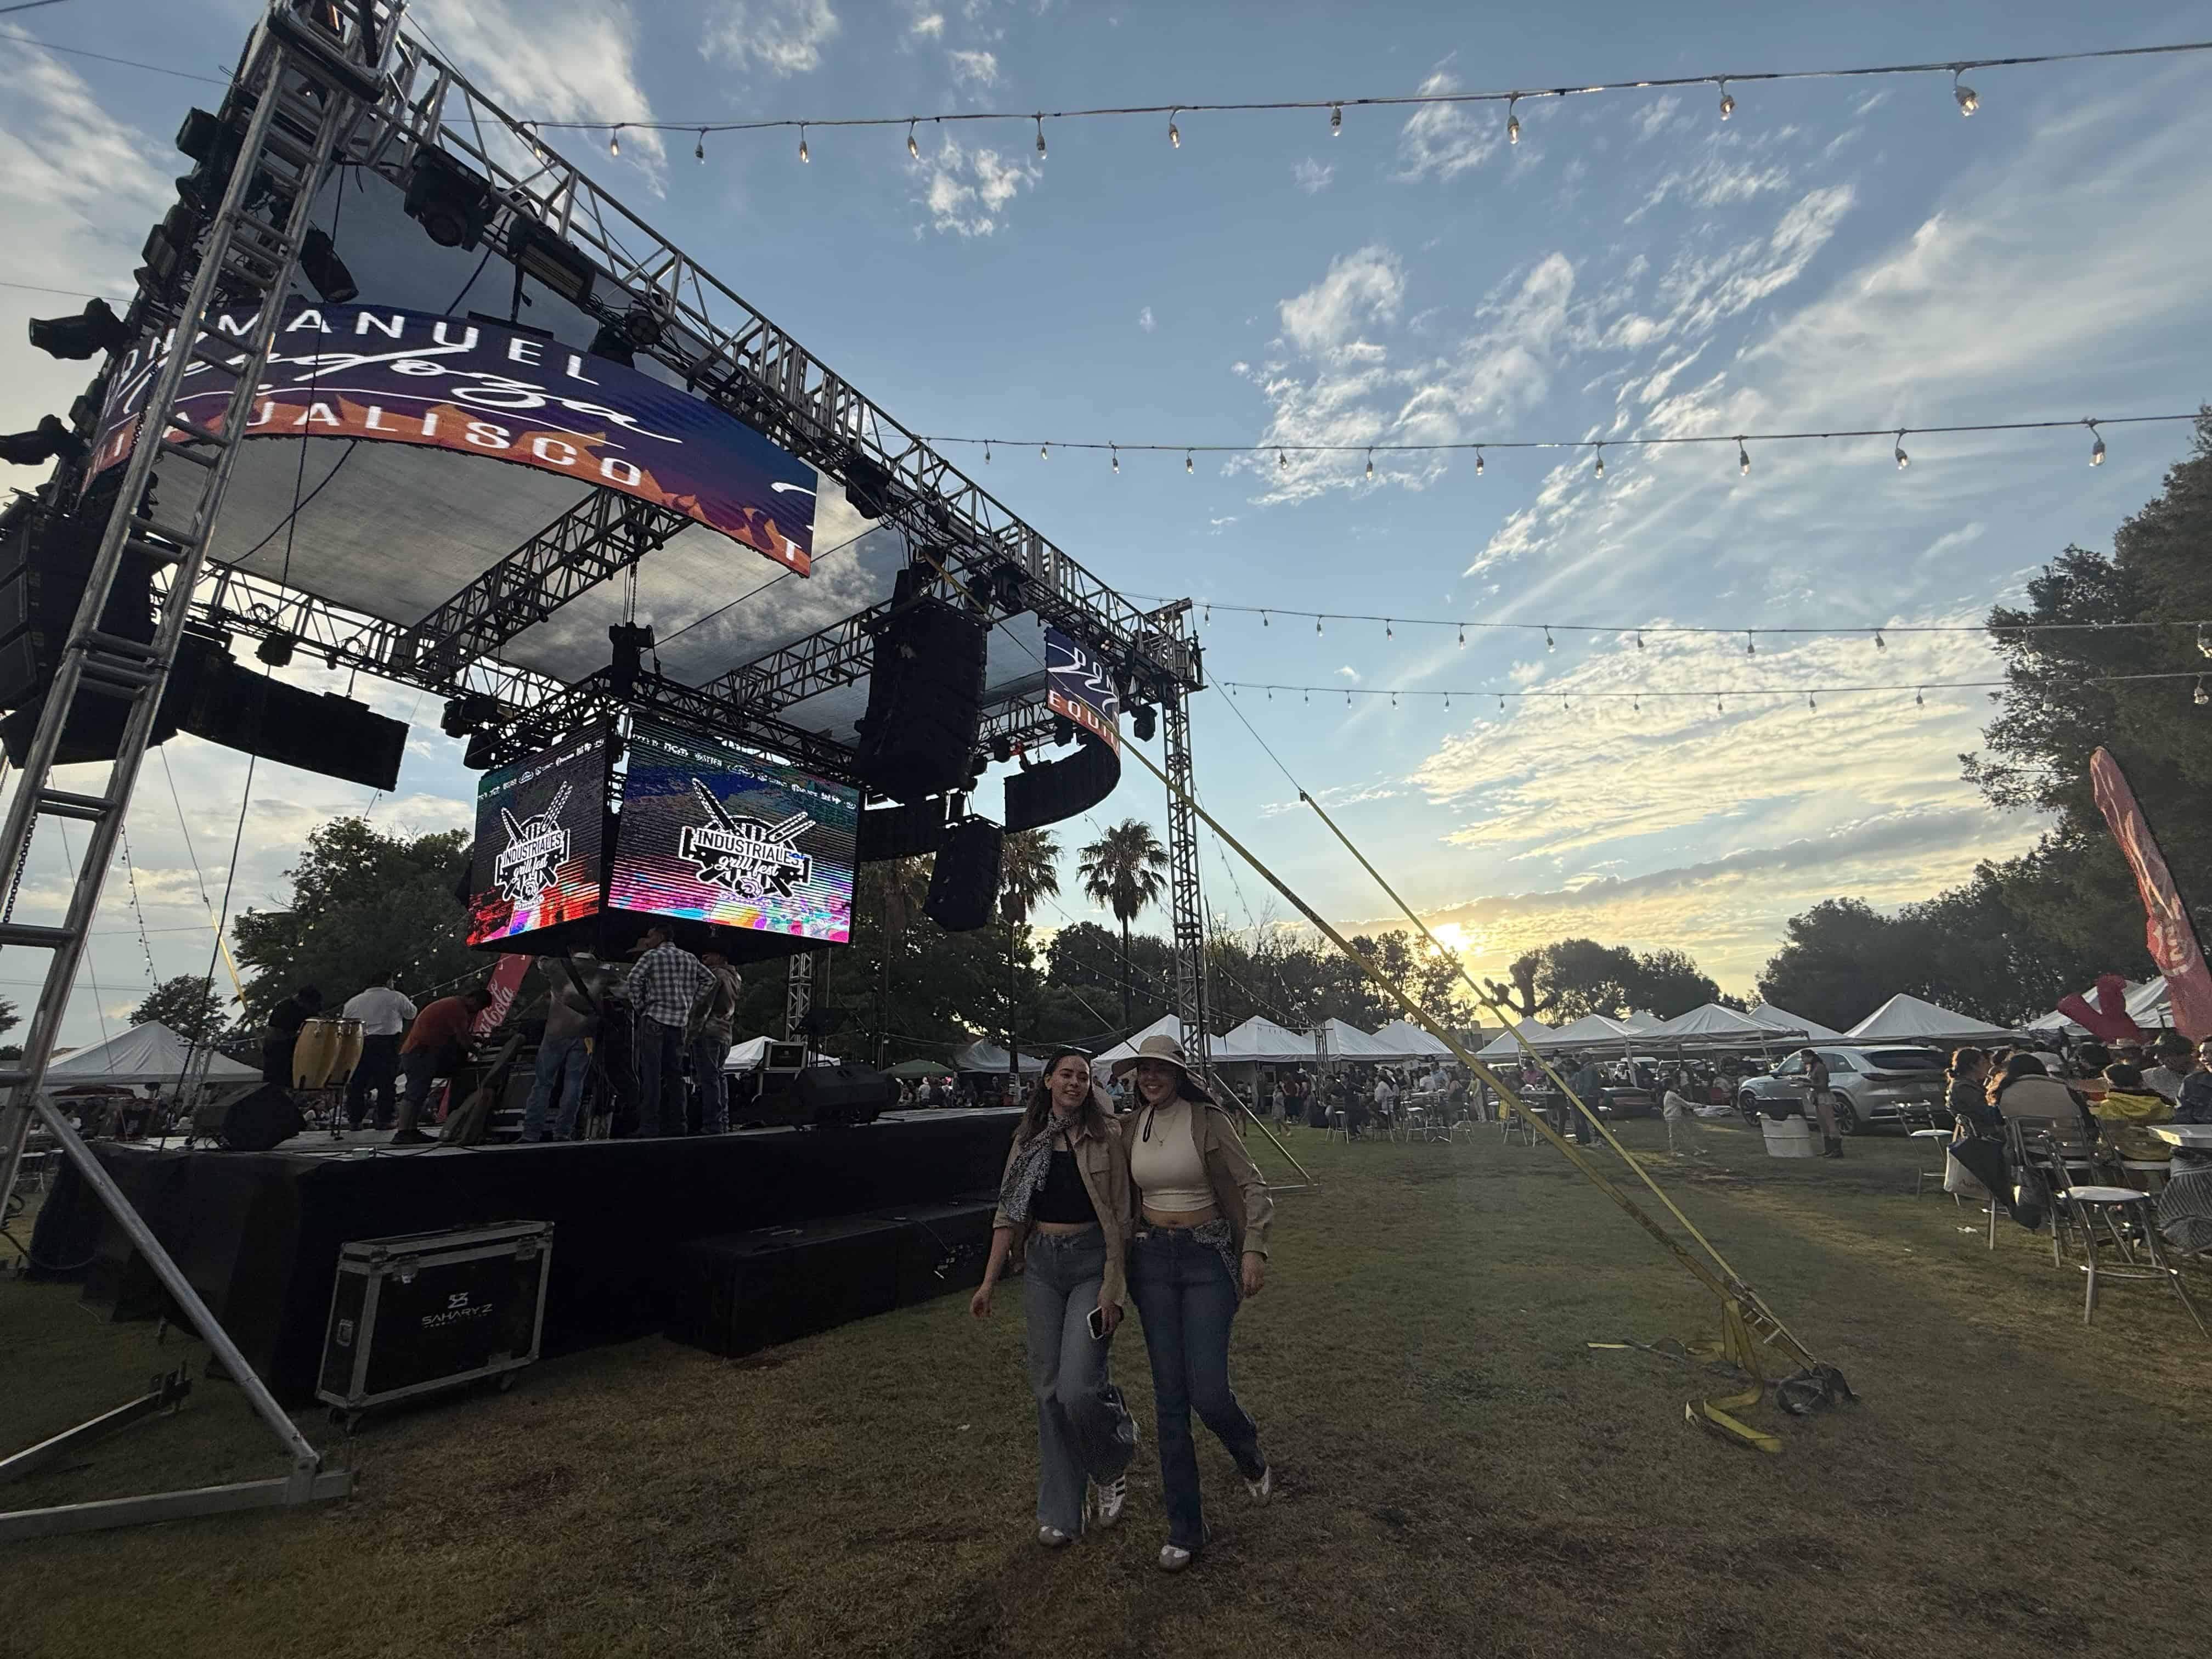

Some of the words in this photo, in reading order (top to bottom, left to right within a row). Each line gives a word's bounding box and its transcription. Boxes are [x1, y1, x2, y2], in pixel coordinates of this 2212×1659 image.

[246, 401, 641, 487] JALISCO
[502, 832, 562, 866] INDUSTRIALES
[697, 830, 800, 866] INDUSTRIALES
[511, 857, 532, 884] grill
[531, 853, 550, 877] fest
[714, 856, 753, 872] grill
[751, 859, 782, 877] fest
